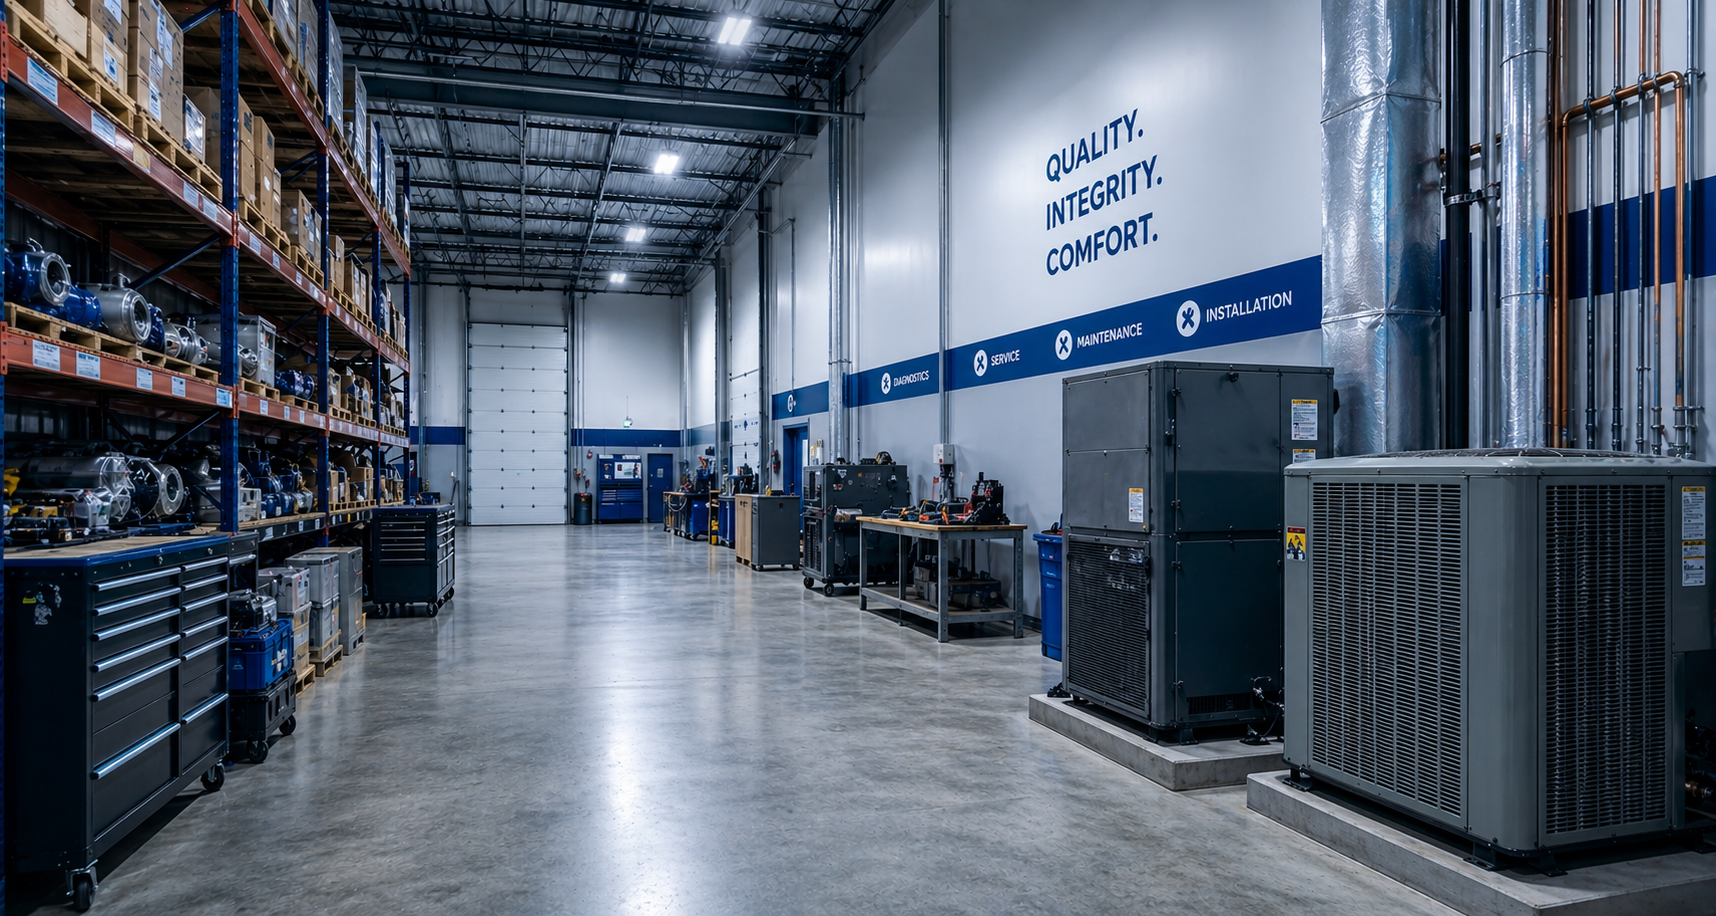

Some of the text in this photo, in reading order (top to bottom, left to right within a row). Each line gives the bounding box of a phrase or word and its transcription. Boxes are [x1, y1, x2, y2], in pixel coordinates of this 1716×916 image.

[1046, 109, 1144, 183] QUALITY.
[1046, 155, 1163, 231] INTEGRITY.
[1046, 212, 1158, 276] COMFORT.
[1206, 291, 1292, 323] INSTALLATION
[1077, 322, 1143, 349] MAINTENANCE
[990, 349, 1020, 367] SERVICE
[893, 370, 930, 387] DIAGNOSTICS
